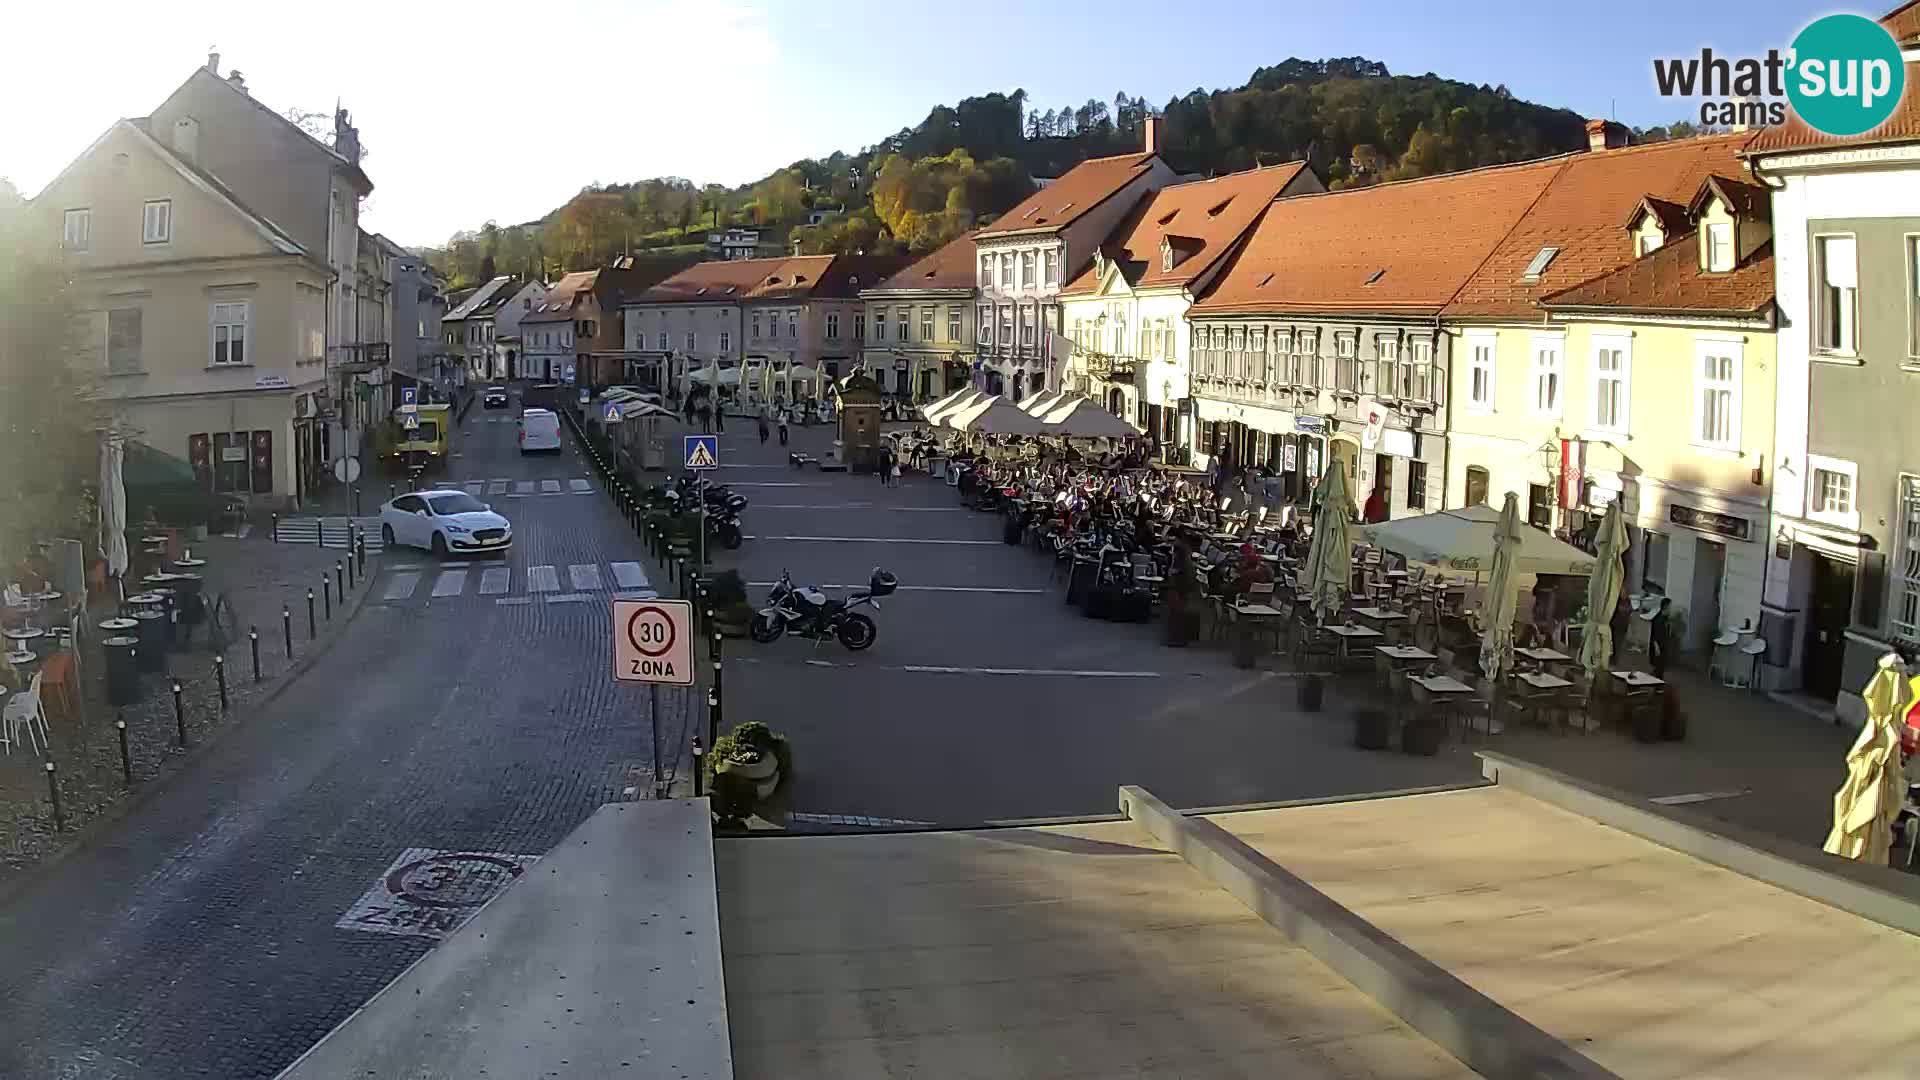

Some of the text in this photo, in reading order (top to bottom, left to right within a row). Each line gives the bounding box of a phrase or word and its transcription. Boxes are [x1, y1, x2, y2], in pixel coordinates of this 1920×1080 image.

[405, 391, 413, 403] P
[640, 622, 665, 644] 30
[631, 659, 676, 677] ZONA
